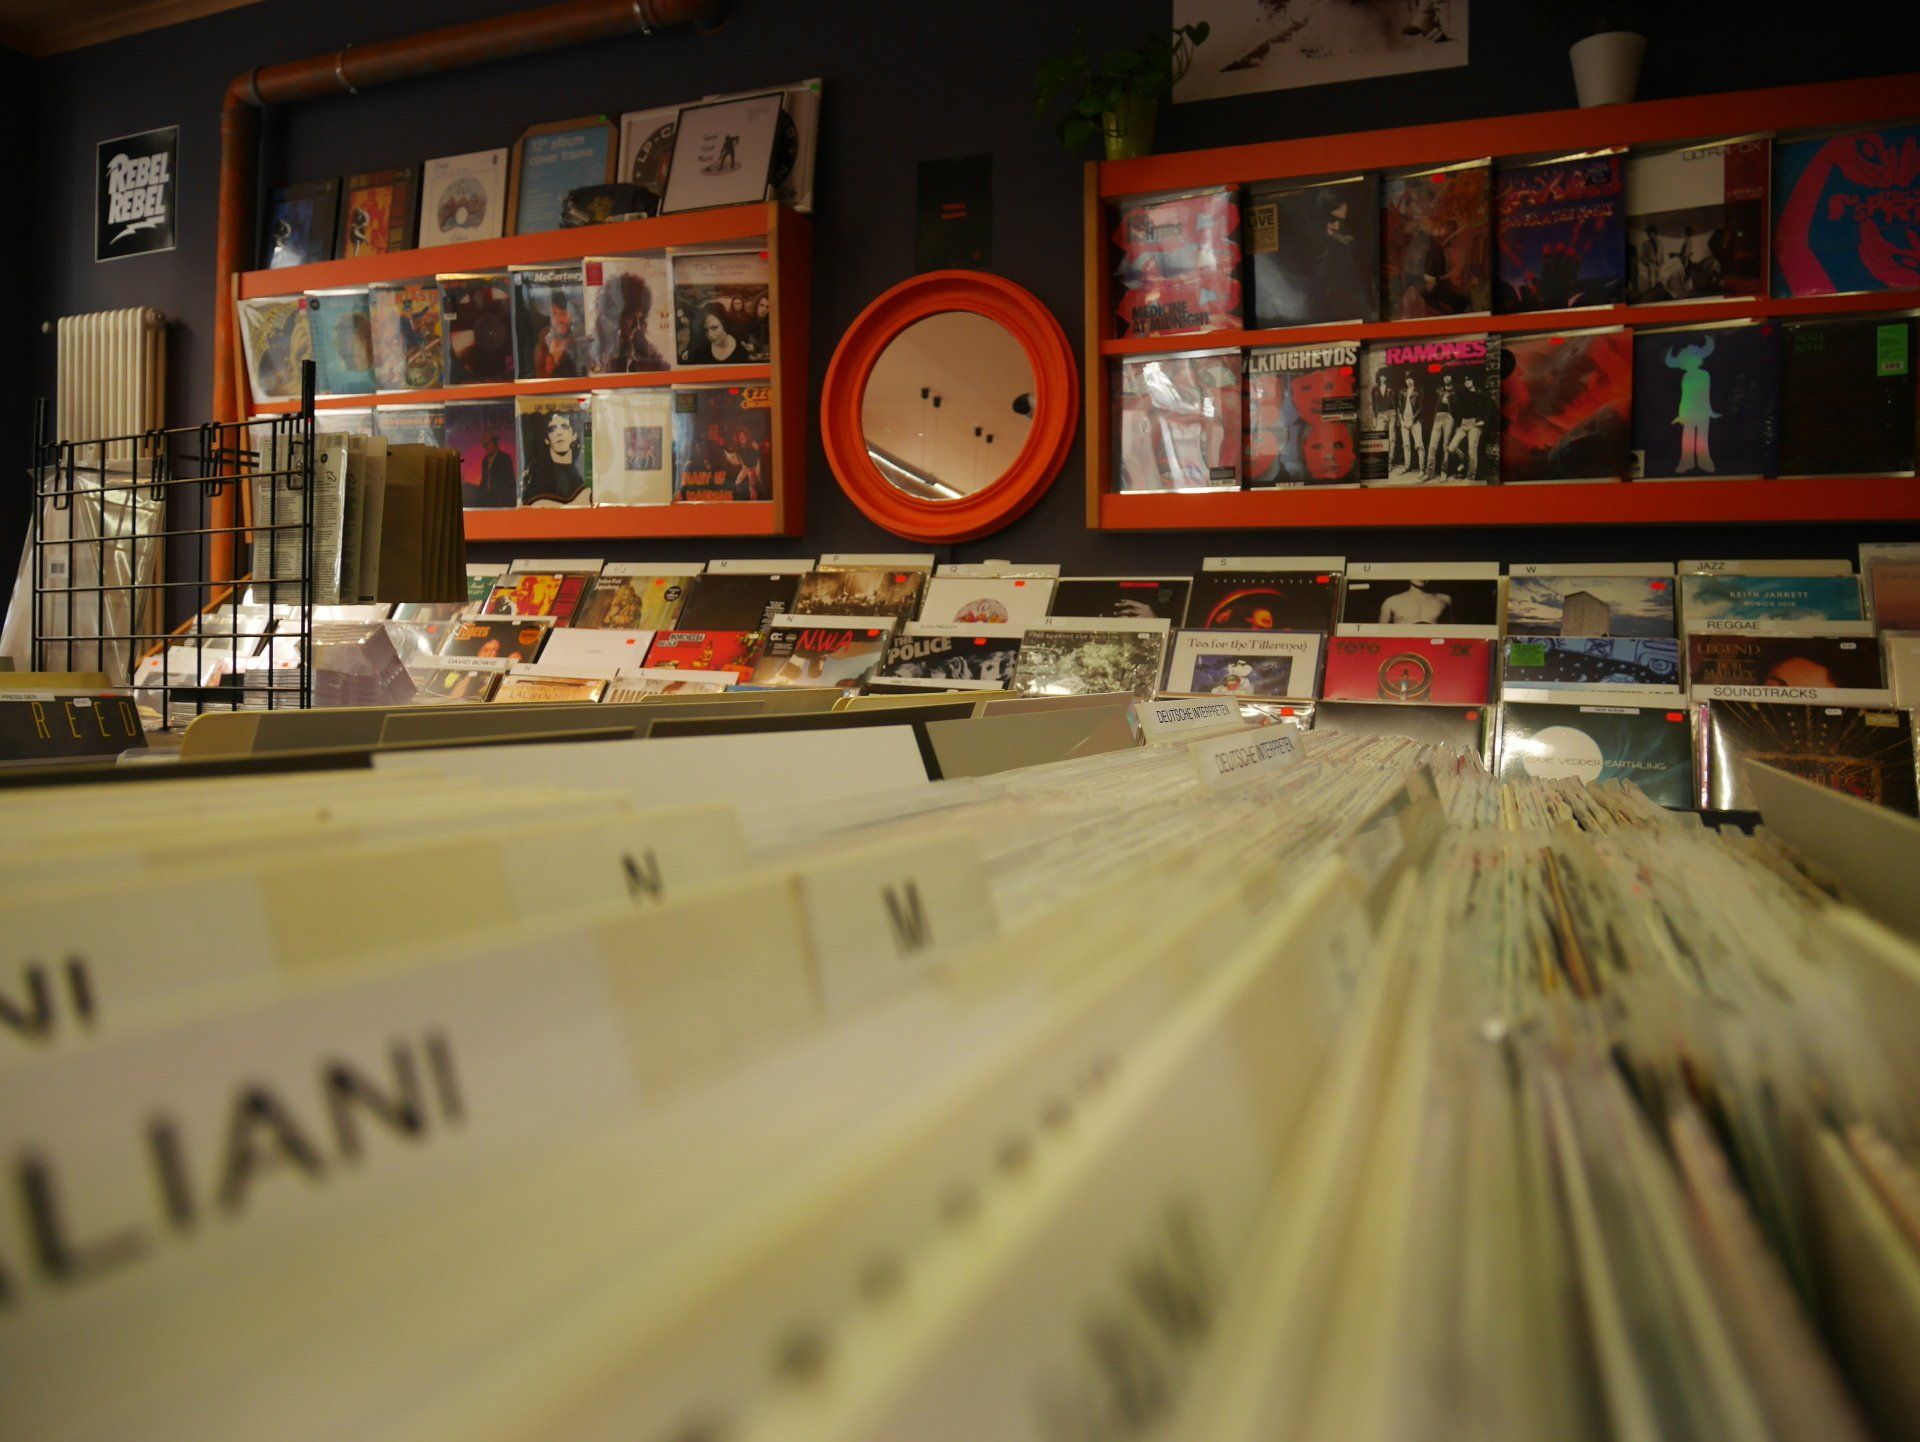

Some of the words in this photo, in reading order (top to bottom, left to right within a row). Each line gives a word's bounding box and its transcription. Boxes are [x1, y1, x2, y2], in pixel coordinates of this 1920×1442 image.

[106, 152, 170, 195] REBEL
[108, 184, 166, 224] REBEL
[1248, 215, 1275, 229] LIVE
[1133, 301, 1188, 319] MEDICINE
[1133, 318, 1149, 333] AT
[1150, 311, 1209, 330] MIDNIGHT
[1386, 341, 1488, 366] RAMONES
[1220, 558, 1227, 566] S
[1363, 563, 1372, 572] U
[1697, 562, 1724, 571] JAZZ
[1526, 565, 1537, 574] W
[1730, 591, 1760, 599] KEITH
[1764, 591, 1809, 599] JARRETT
[1354, 624, 1361, 632] T
[1708, 621, 1761, 630] REGGAE
[893, 635, 913, 647] THE
[1187, 637, 1211, 650] Tea
[1211, 638, 1228, 650] for
[1229, 638, 1248, 652] the
[1248, 639, 1307, 654] Tillerman
[887, 637, 953, 664] POLICE
[1336, 642, 1381, 655] TOTO
[1696, 642, 1761, 656] LEGEND
[1714, 686, 1818, 700] SOUNDTRACKS
[1156, 709, 1193, 724] DEUTSCHE
[1193, 704, 1231, 719] INTERPRETEN
[1215, 744, 1258, 774] DEUTSCHE
[1257, 736, 1295, 762] INTERPRETEN
[1559, 757, 1601, 766] VEDDER
[1605, 759, 1667, 770] EARTHLING
[622, 845, 664, 908] N
[0, 1024, 468, 1320] LIANI
